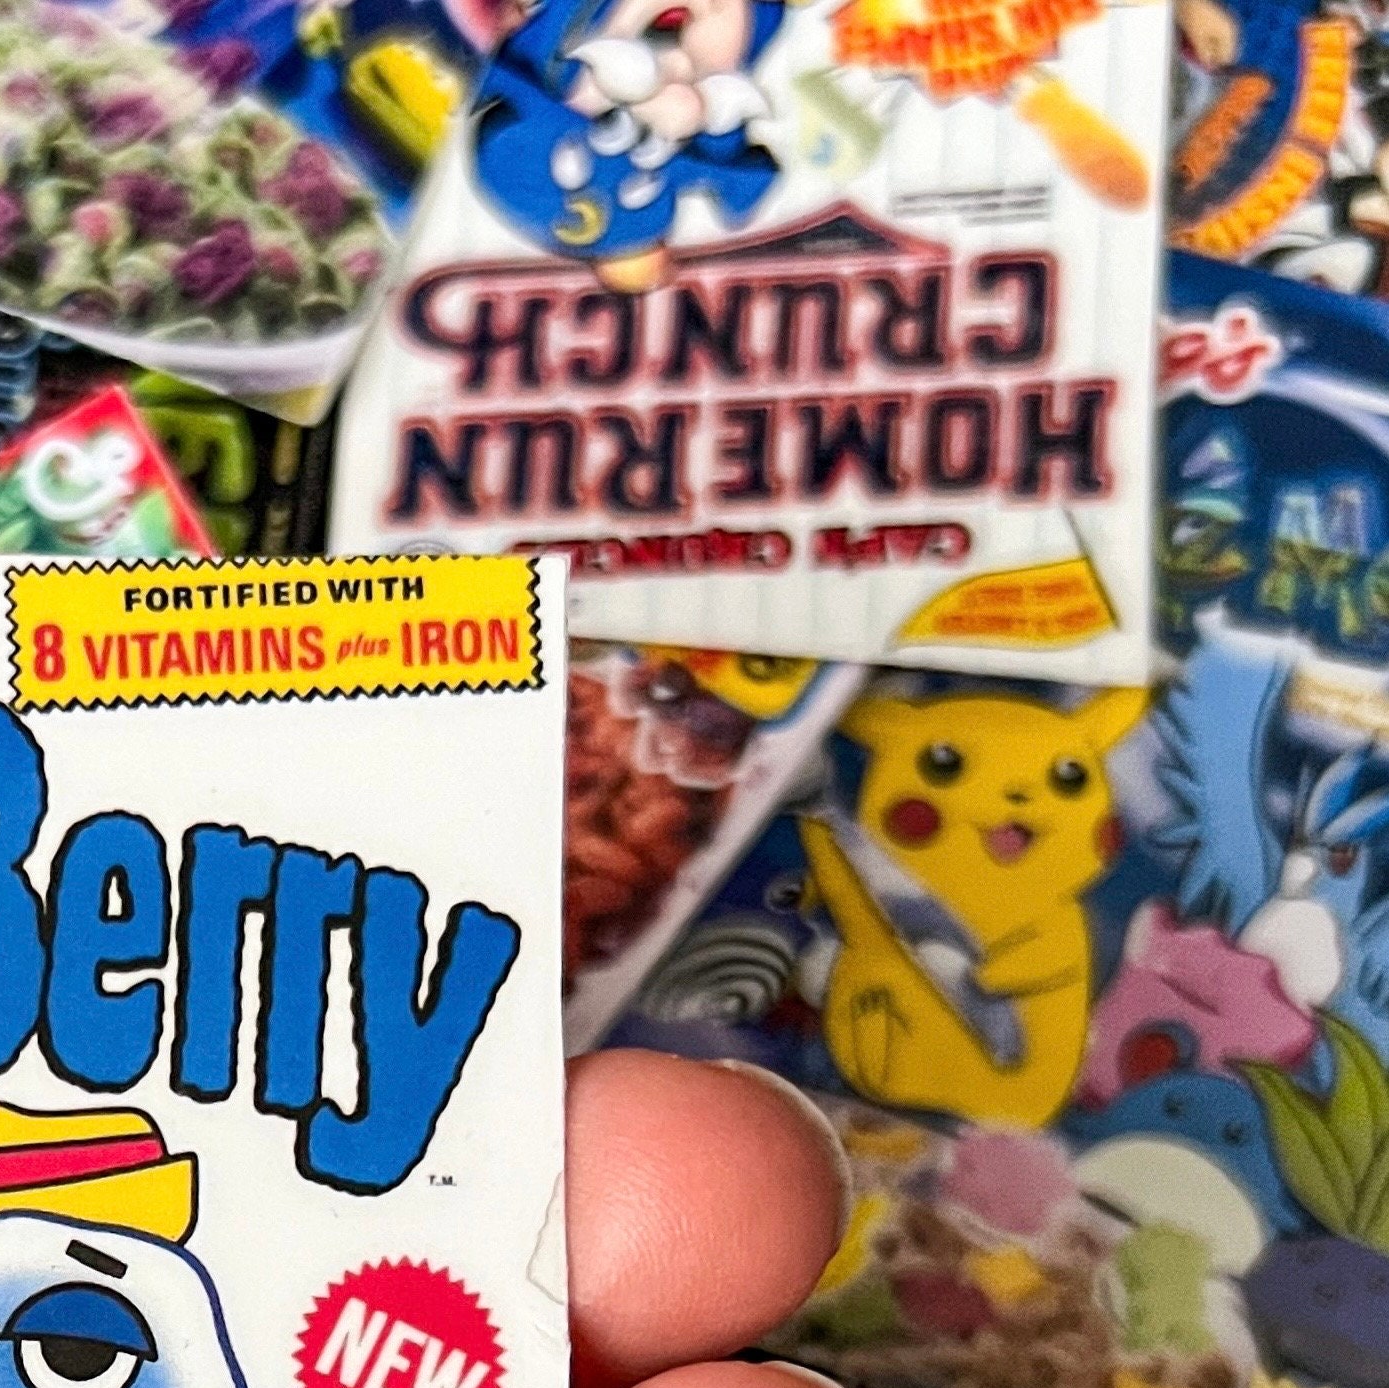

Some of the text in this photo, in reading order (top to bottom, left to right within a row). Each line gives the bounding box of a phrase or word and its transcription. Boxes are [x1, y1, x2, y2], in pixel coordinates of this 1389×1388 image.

[400, 250, 1058, 392] CRUNCH
[384, 402, 693, 527] RUN
[709, 378, 1117, 503] HOME
[32, 617, 520, 683] 8 VITAMINS plus IRON
[123, 575, 426, 613] FORTIFIED WITH
